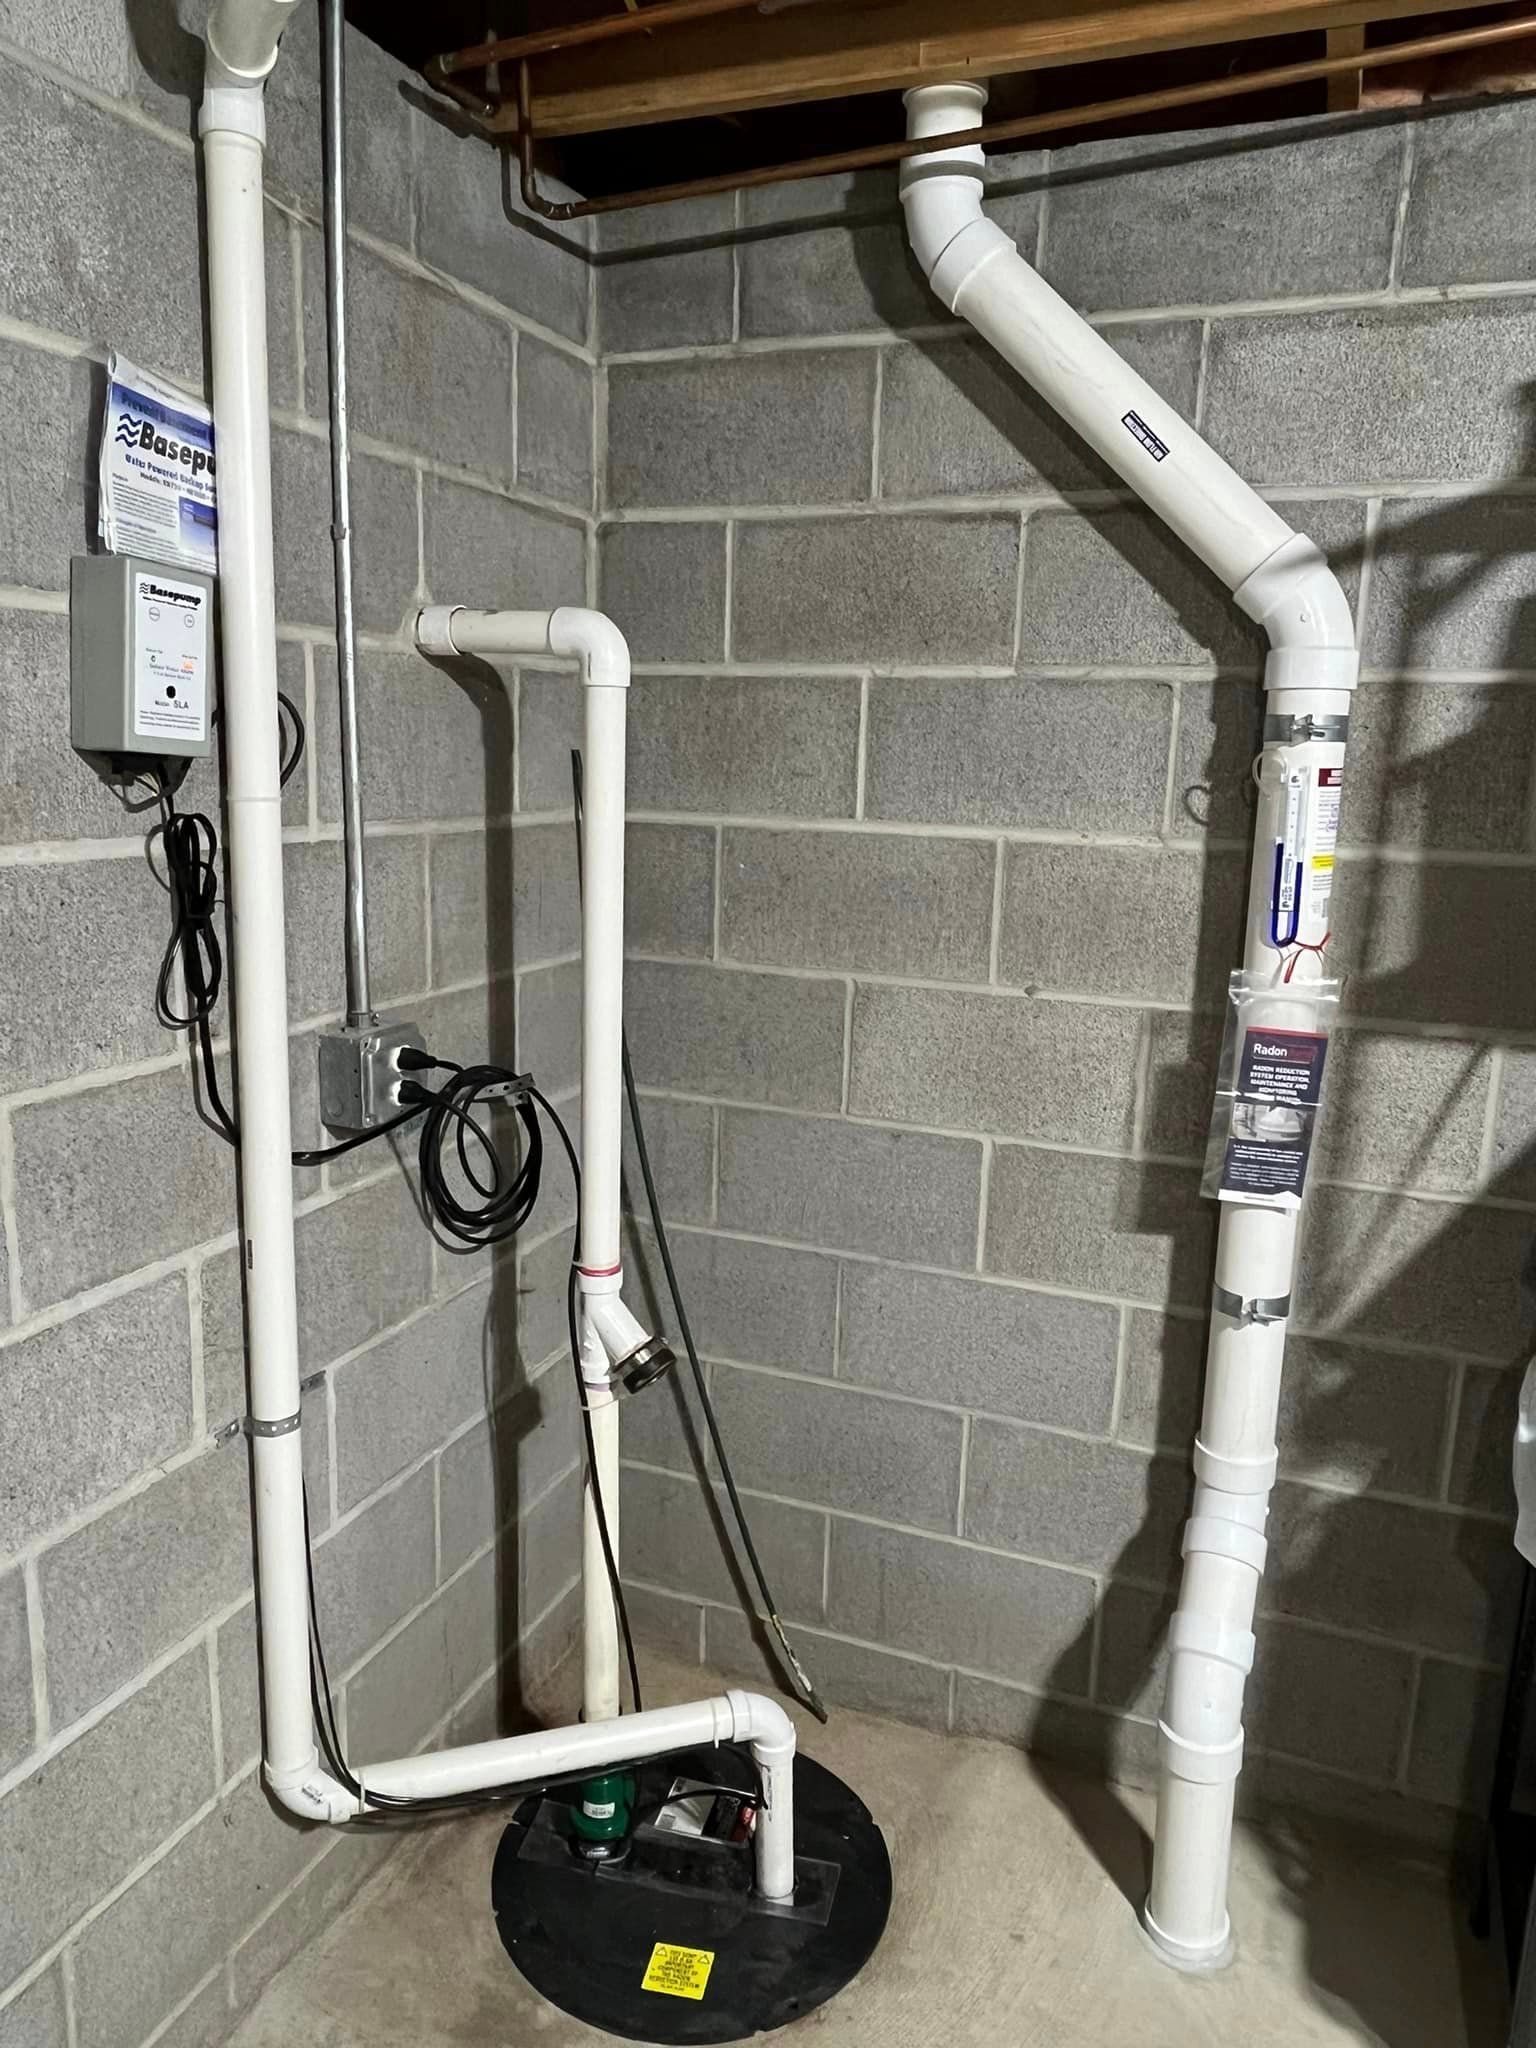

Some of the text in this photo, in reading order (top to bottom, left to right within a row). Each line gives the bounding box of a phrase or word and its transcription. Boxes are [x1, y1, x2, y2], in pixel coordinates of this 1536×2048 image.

[149, 585, 201, 606] Basepump
[1254, 1043, 1288, 1057] Radon
[1276, 1067, 1310, 1075] REDUCTION
[1250, 1072, 1273, 1080] SYSTEM
[1250, 1079, 1293, 1088] MAINTENANCE
